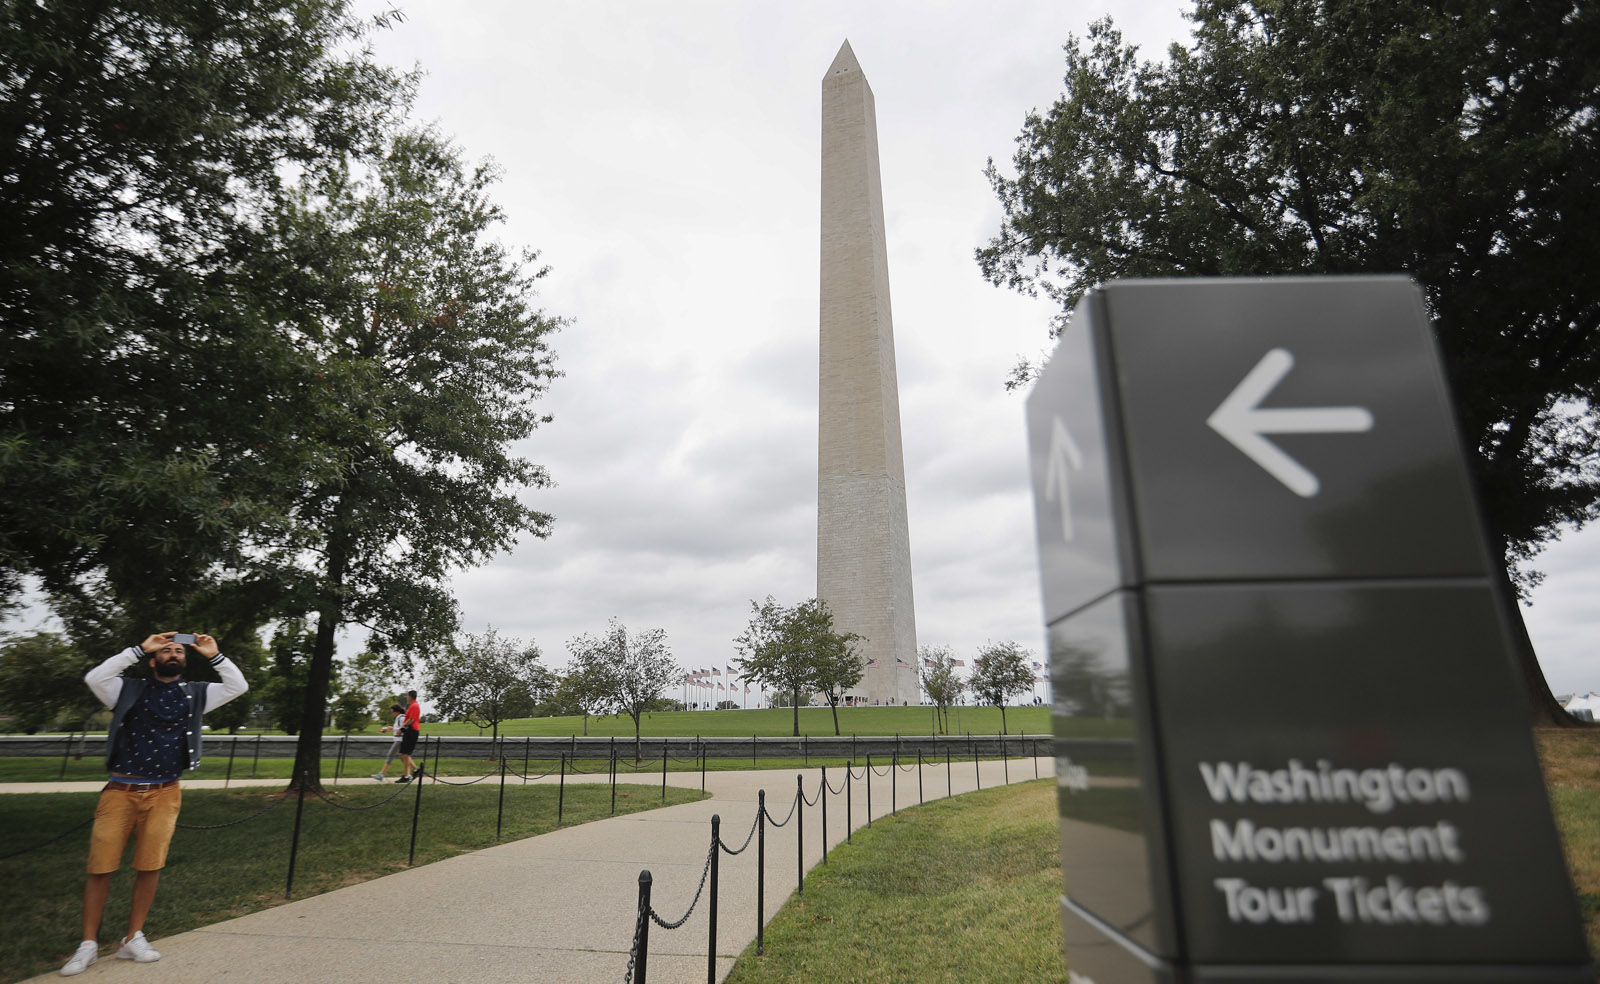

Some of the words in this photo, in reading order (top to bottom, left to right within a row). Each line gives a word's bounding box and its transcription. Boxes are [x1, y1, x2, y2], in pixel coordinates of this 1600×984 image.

[1199, 759, 1468, 812] Washington
[1210, 818, 1463, 862] Monument
[1214, 877, 1317, 922] Tour
[1323, 876, 1490, 924] Tickets
